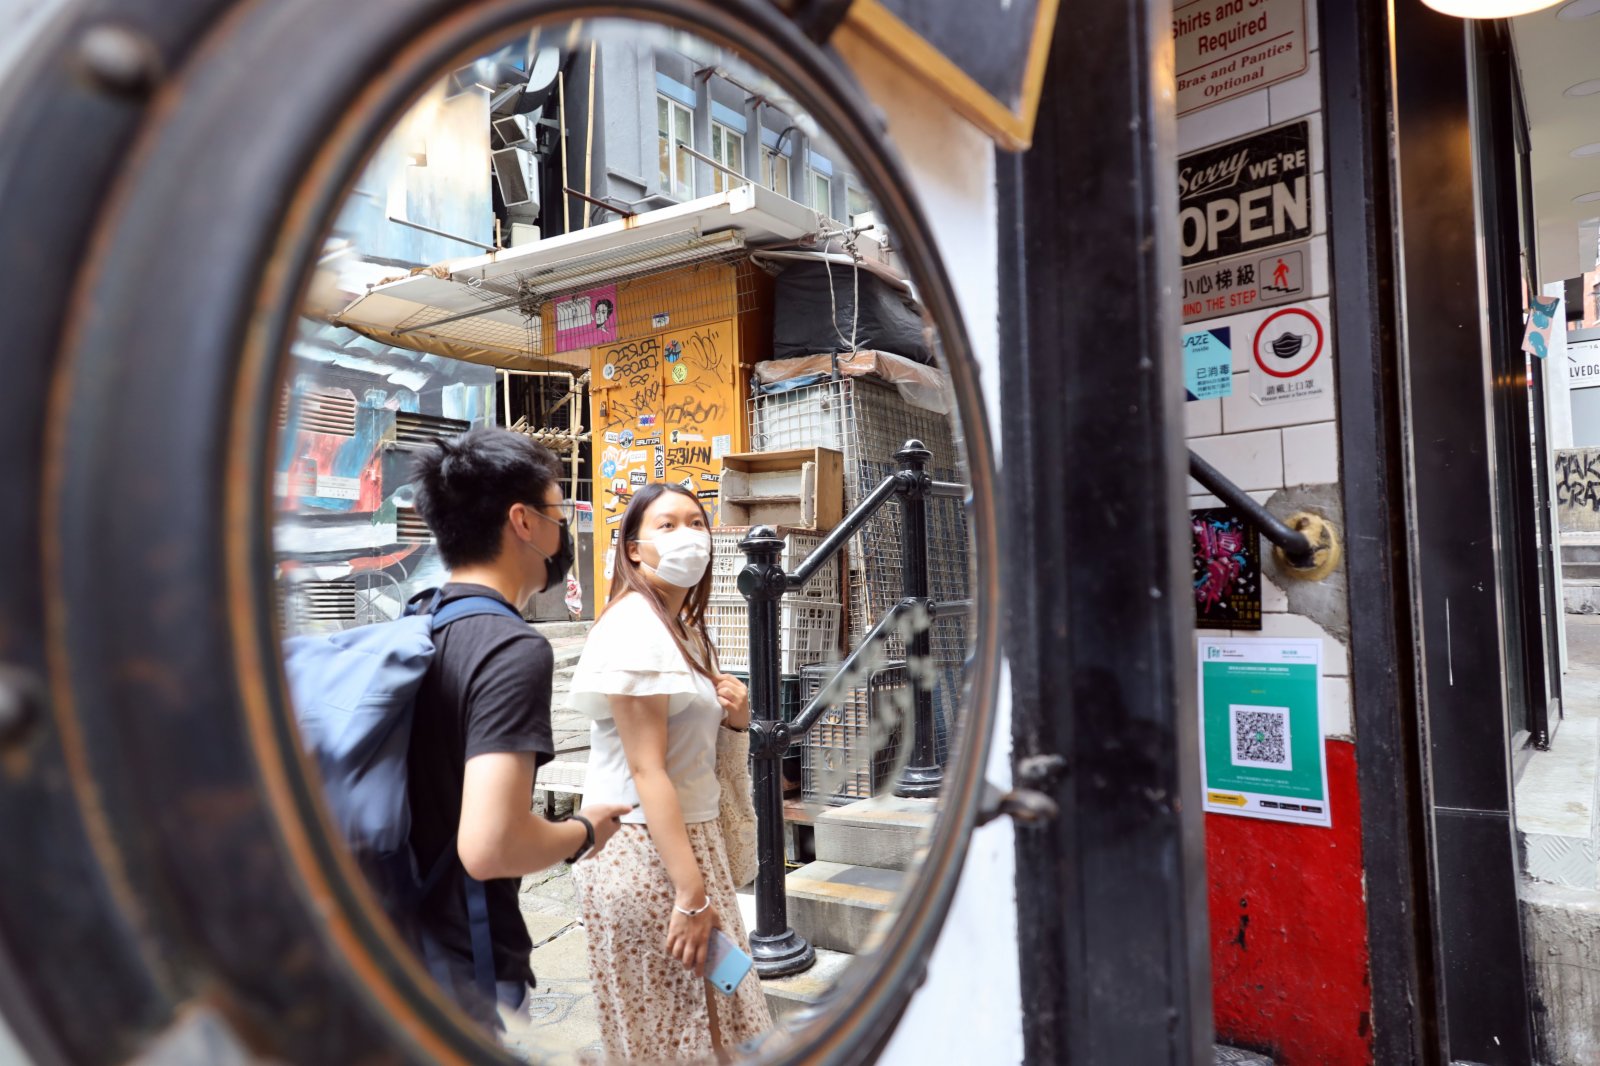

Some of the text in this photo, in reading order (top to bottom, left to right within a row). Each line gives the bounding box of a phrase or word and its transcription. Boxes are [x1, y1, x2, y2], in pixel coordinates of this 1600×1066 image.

[1173, 0, 1243, 39] Shirts and
[1198, 11, 1267, 55] Required
[1177, 42, 1293, 91] Bras and Panties
[1204, 66, 1265, 97] Optional
[1180, 149, 1306, 199] Sorry WE'RE
[1180, 176, 1307, 257] OPEN
[1182, 264, 1256, 299] 小心梯級
[1206, 296, 1225, 312] THE
[1230, 289, 1257, 307] STEP
